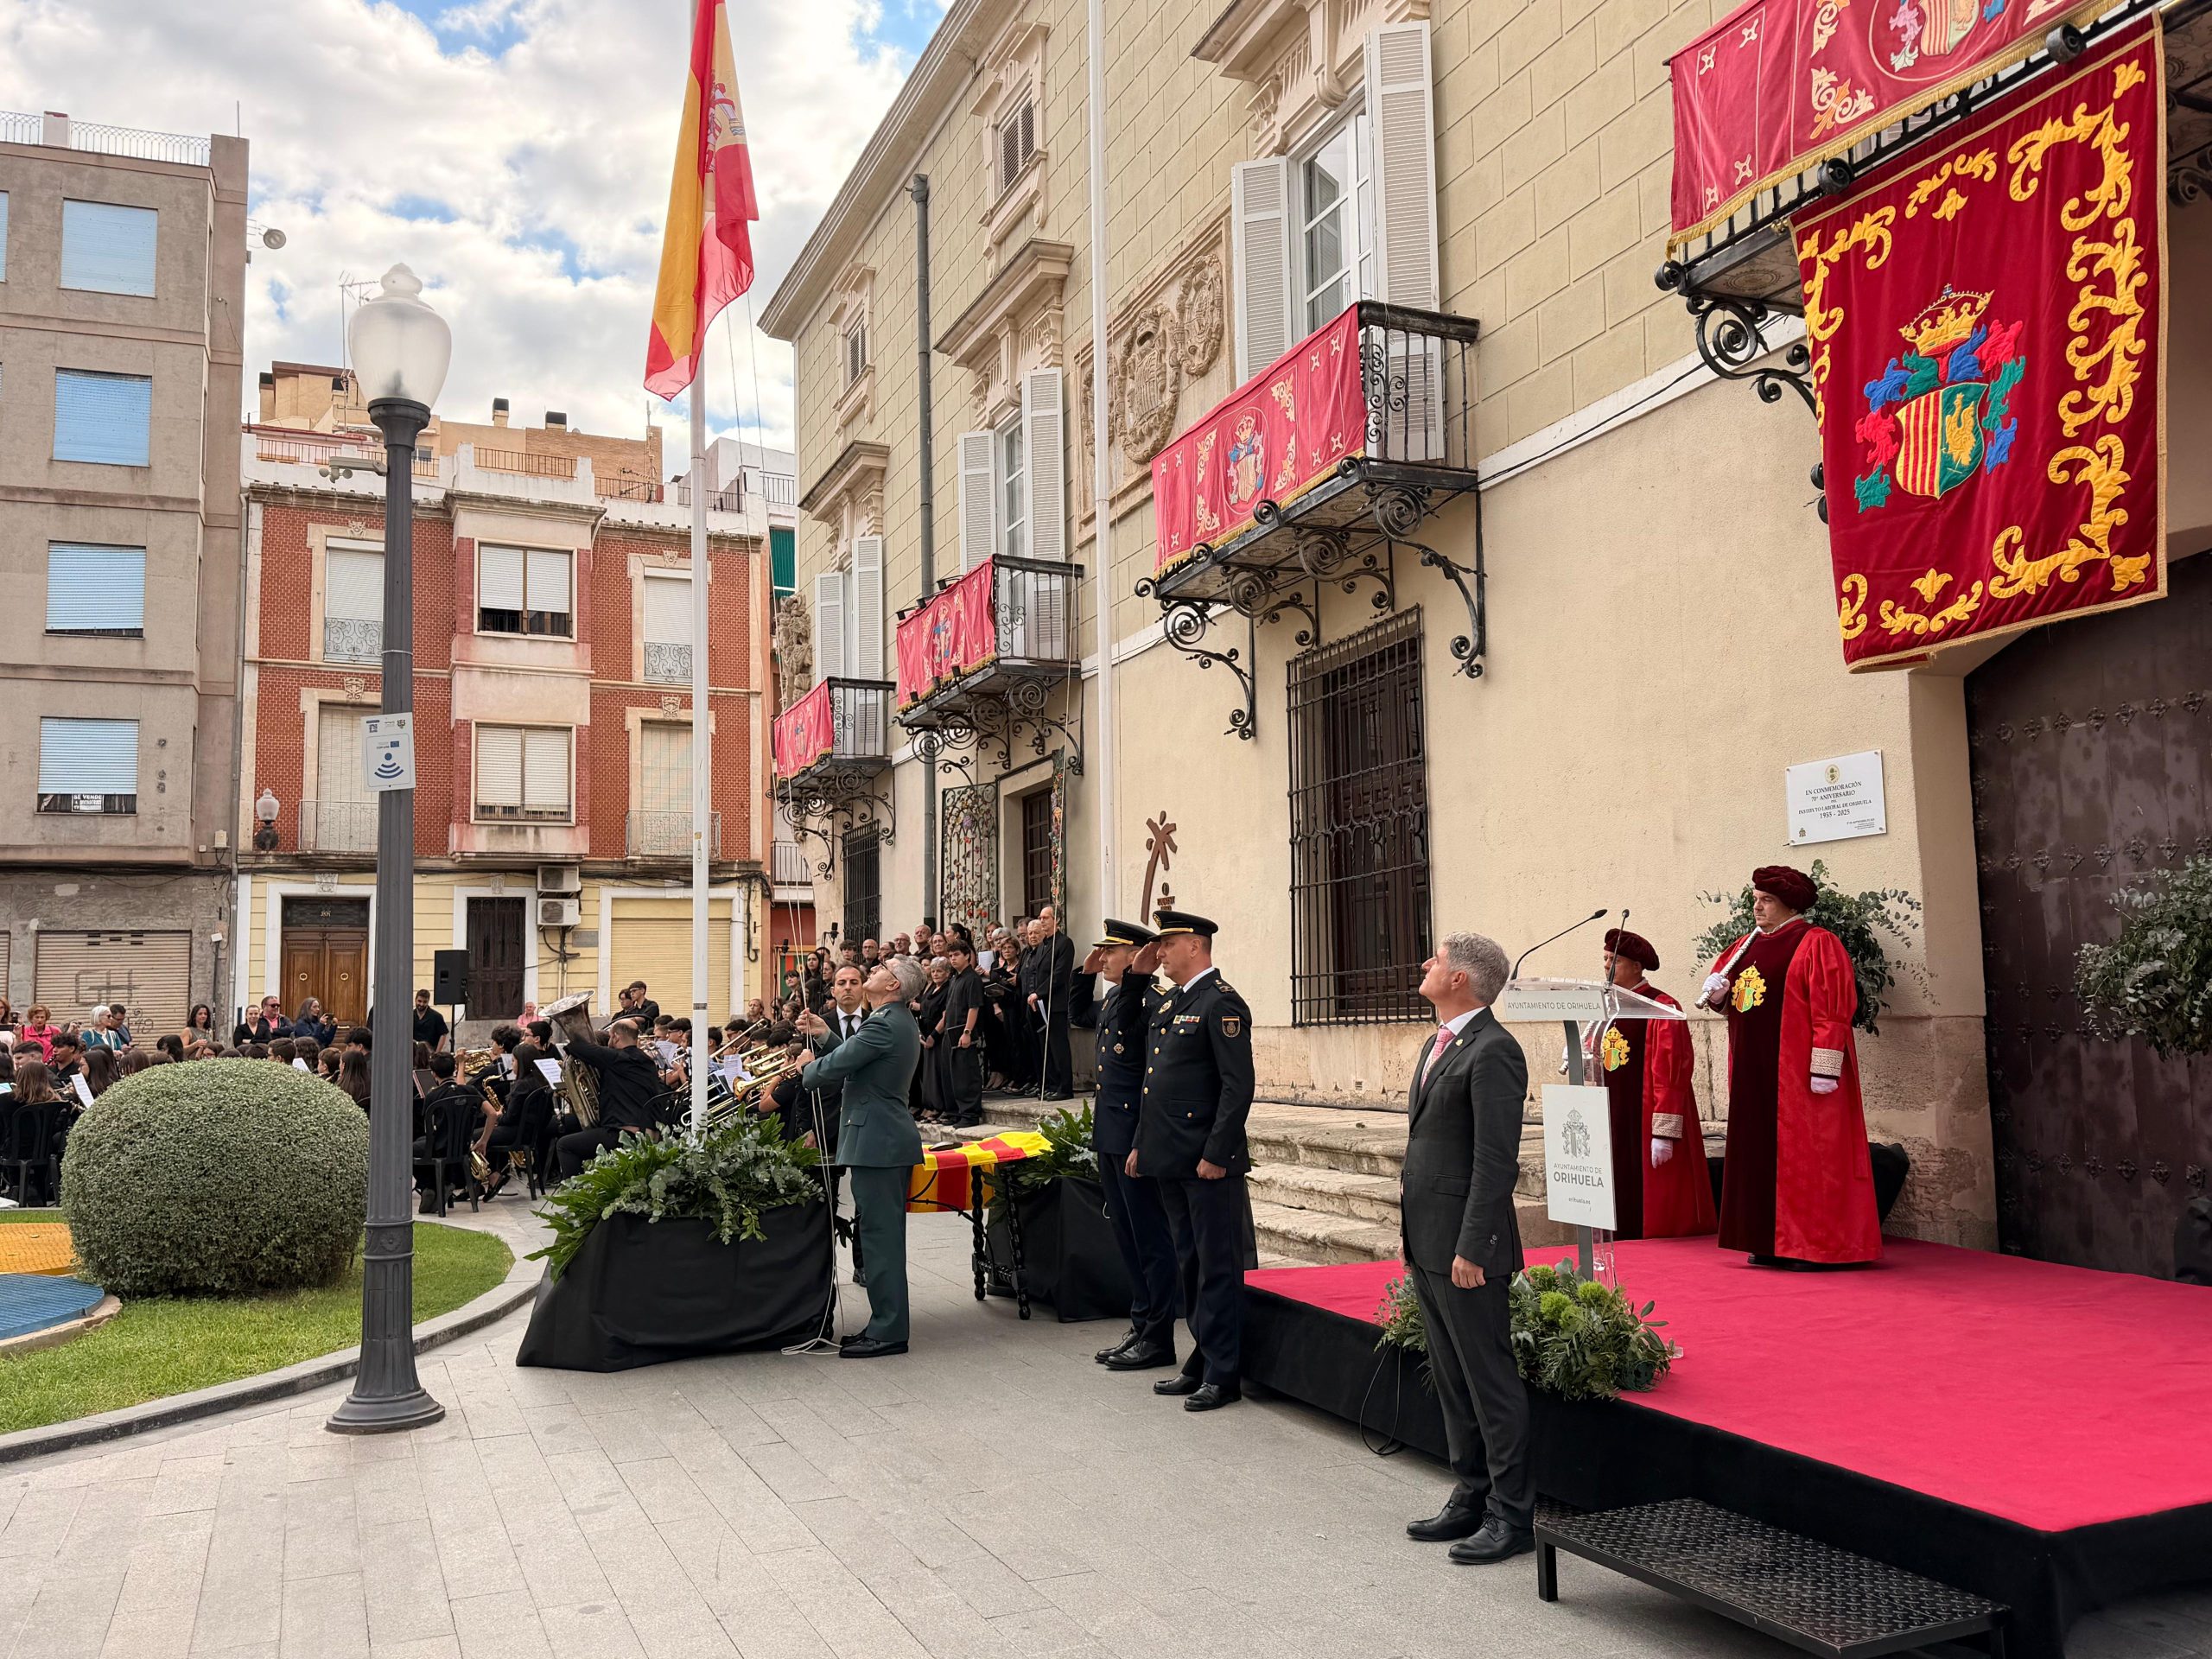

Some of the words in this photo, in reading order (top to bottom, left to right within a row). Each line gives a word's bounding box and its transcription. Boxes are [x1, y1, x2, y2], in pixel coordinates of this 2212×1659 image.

[1813, 781, 1862, 794] CONMEMORACIÓN
[1819, 790, 1856, 800] ANIVERSARIO
[1556, 1001, 1567, 1010] DE
[1554, 1162, 1594, 1173] AYUNTAMIENTO
[1554, 1171, 1605, 1188] ORIHUELA
